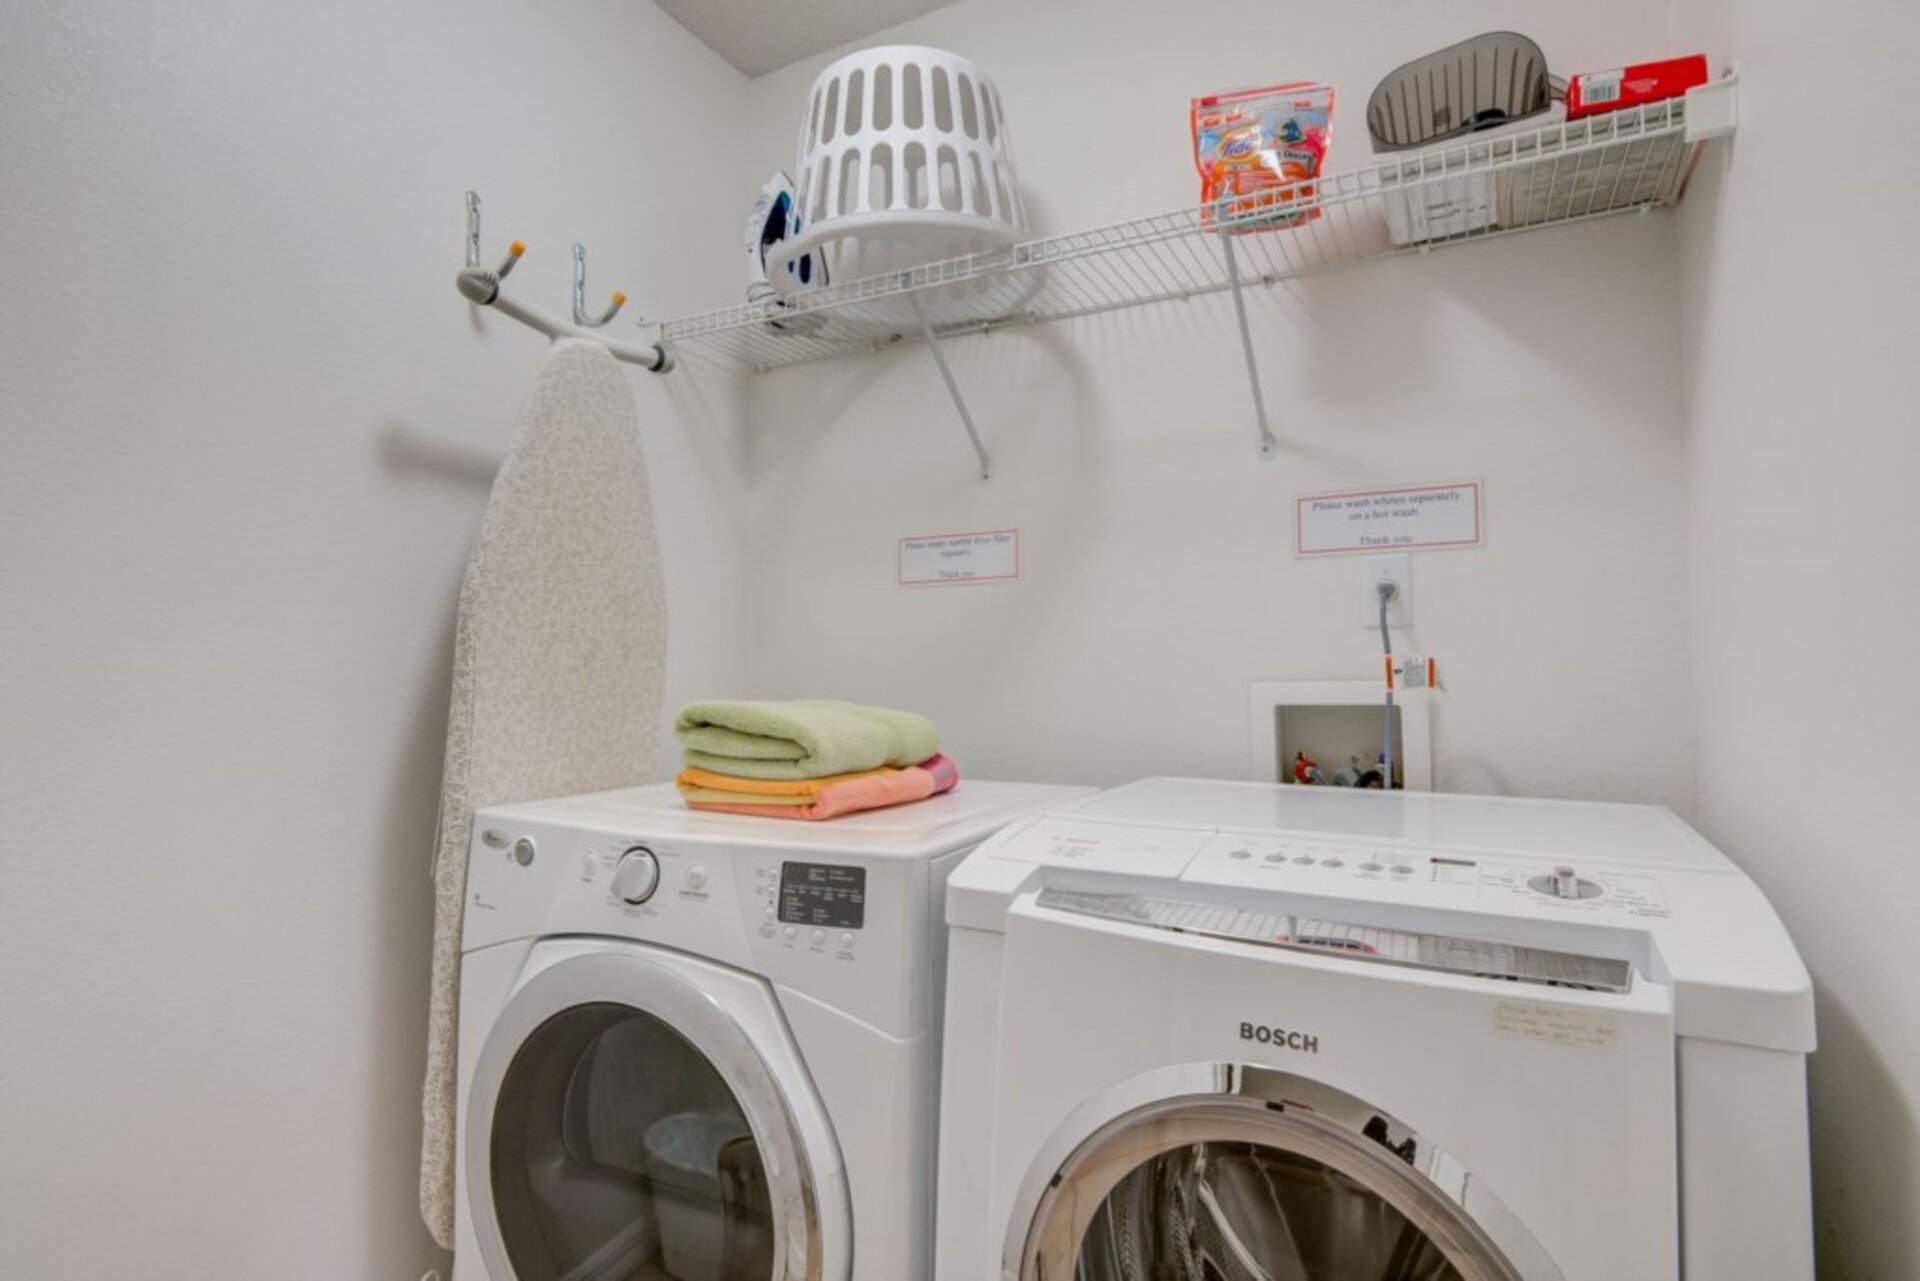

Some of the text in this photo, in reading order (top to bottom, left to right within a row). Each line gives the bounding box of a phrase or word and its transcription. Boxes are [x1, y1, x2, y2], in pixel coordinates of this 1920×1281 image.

[1312, 502, 1342, 511] Please
[1346, 499, 1370, 508] wash
[1409, 491, 1460, 505] separately
[1373, 509, 1388, 518] hot
[1360, 535, 1412, 546] Thank you
[1240, 1021, 1318, 1054] BOSCH
